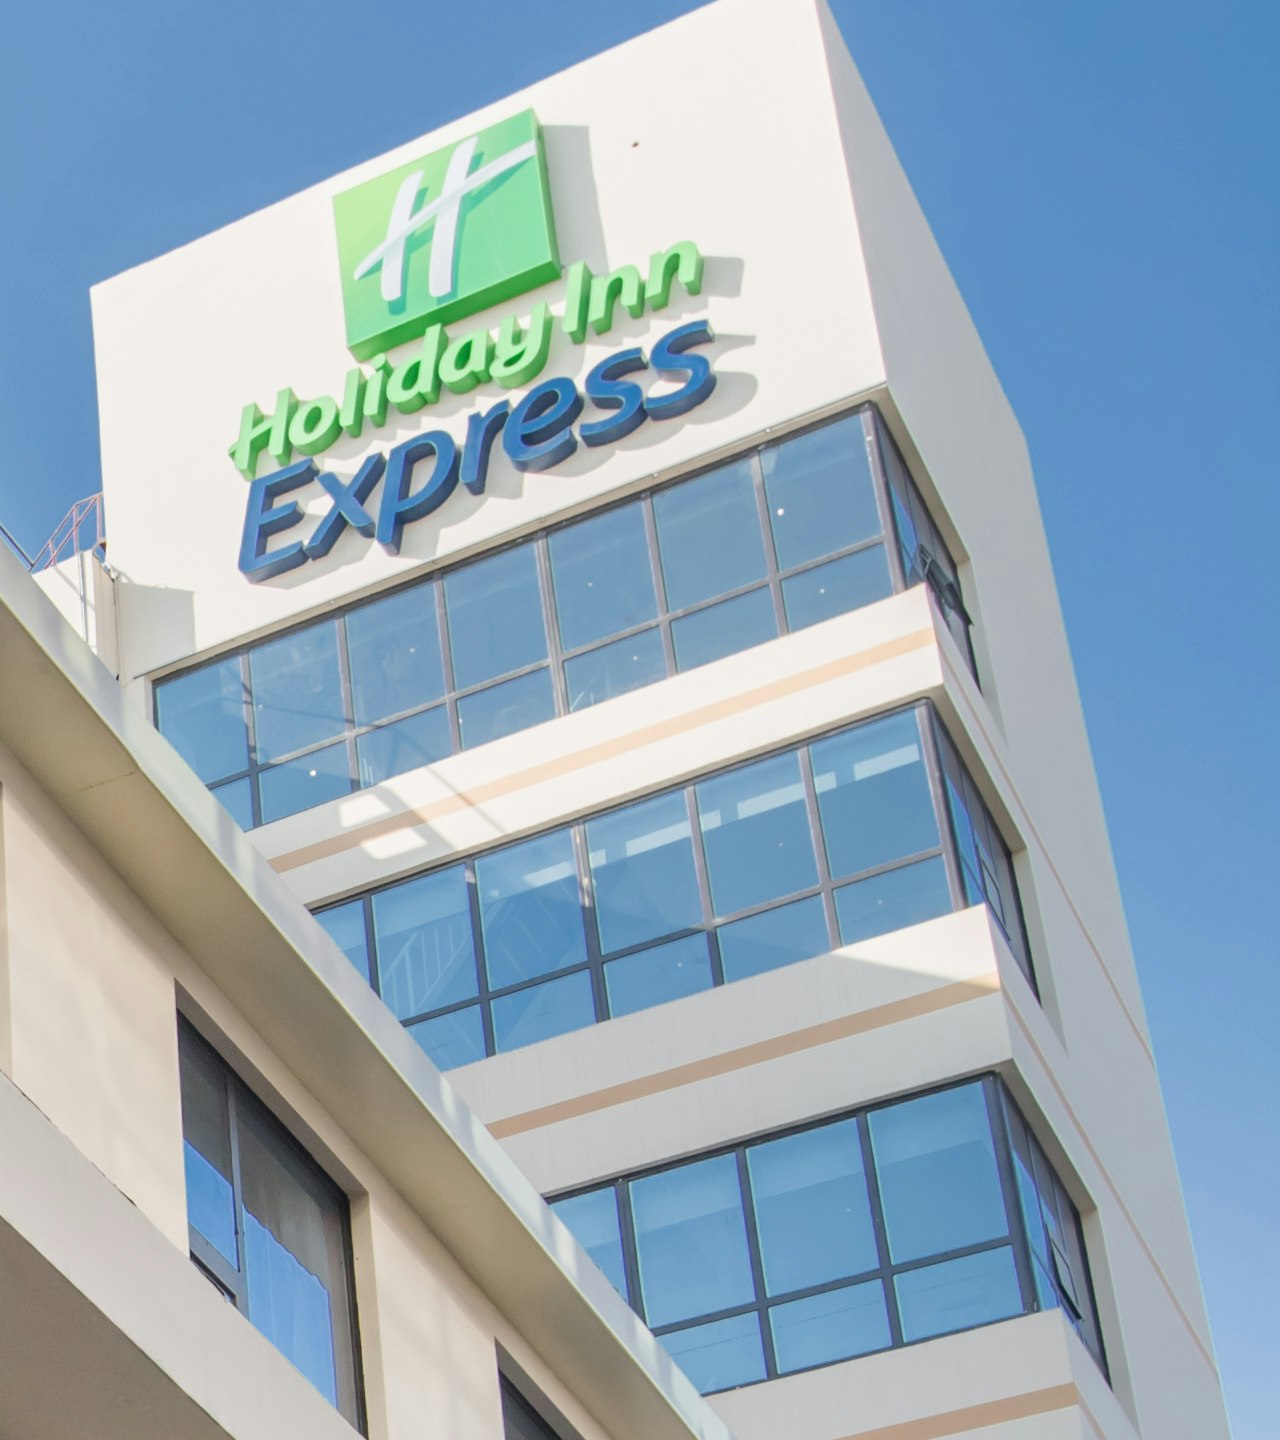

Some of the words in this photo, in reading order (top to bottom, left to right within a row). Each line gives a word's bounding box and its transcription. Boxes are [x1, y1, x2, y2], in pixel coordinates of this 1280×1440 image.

[229, 301, 554, 480] Holiday
[562, 239, 704, 345] Inn
[237, 318, 717, 583] Express
